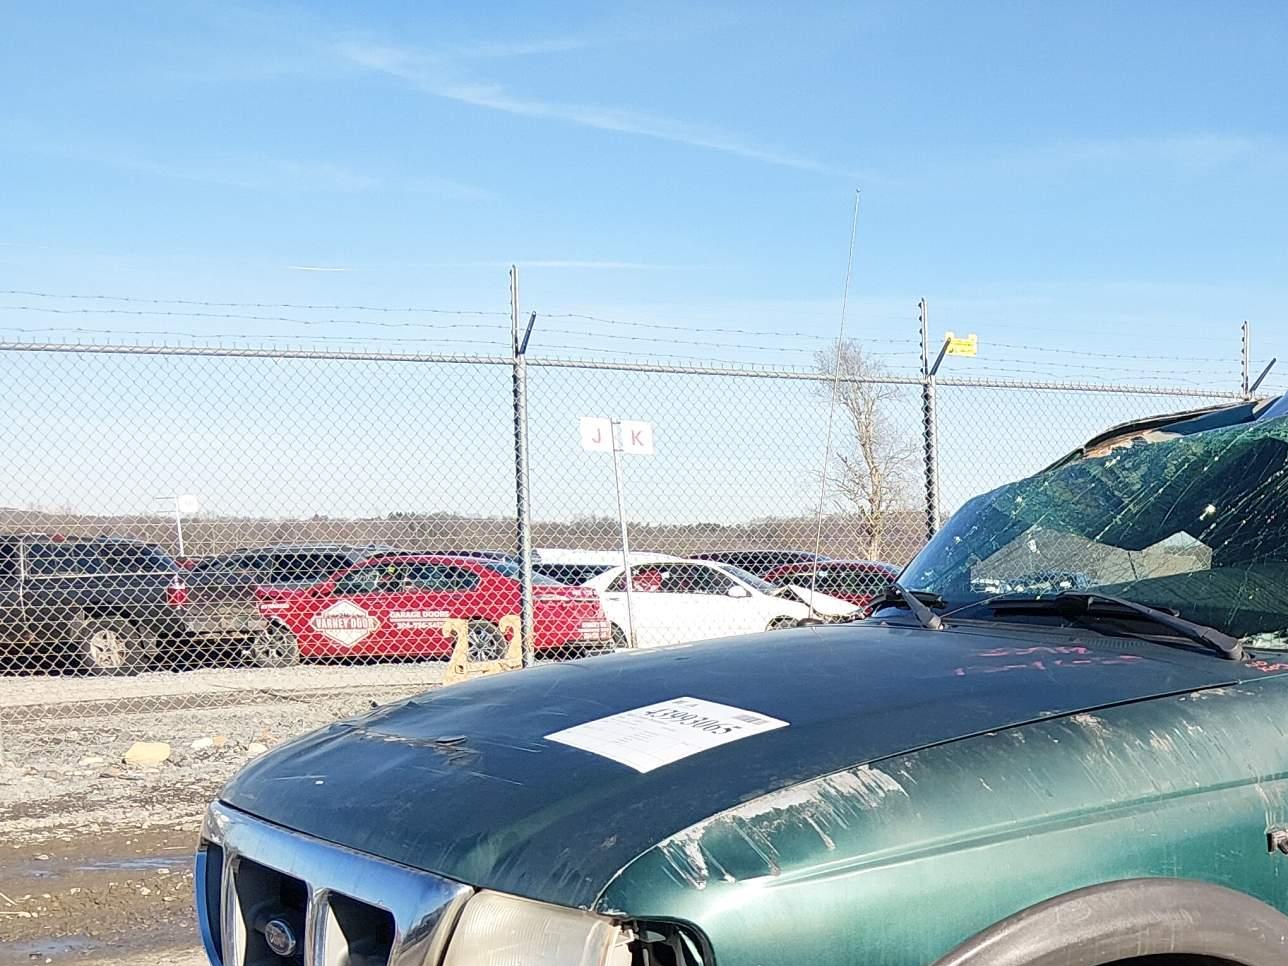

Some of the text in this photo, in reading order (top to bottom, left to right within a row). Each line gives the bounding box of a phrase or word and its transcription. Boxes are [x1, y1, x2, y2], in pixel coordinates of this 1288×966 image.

[591, 427, 602, 444] J
[630, 429, 645, 446] K
[316, 618, 374, 629] VARNEY DOOR
[644, 707, 742, 735] 43993065
